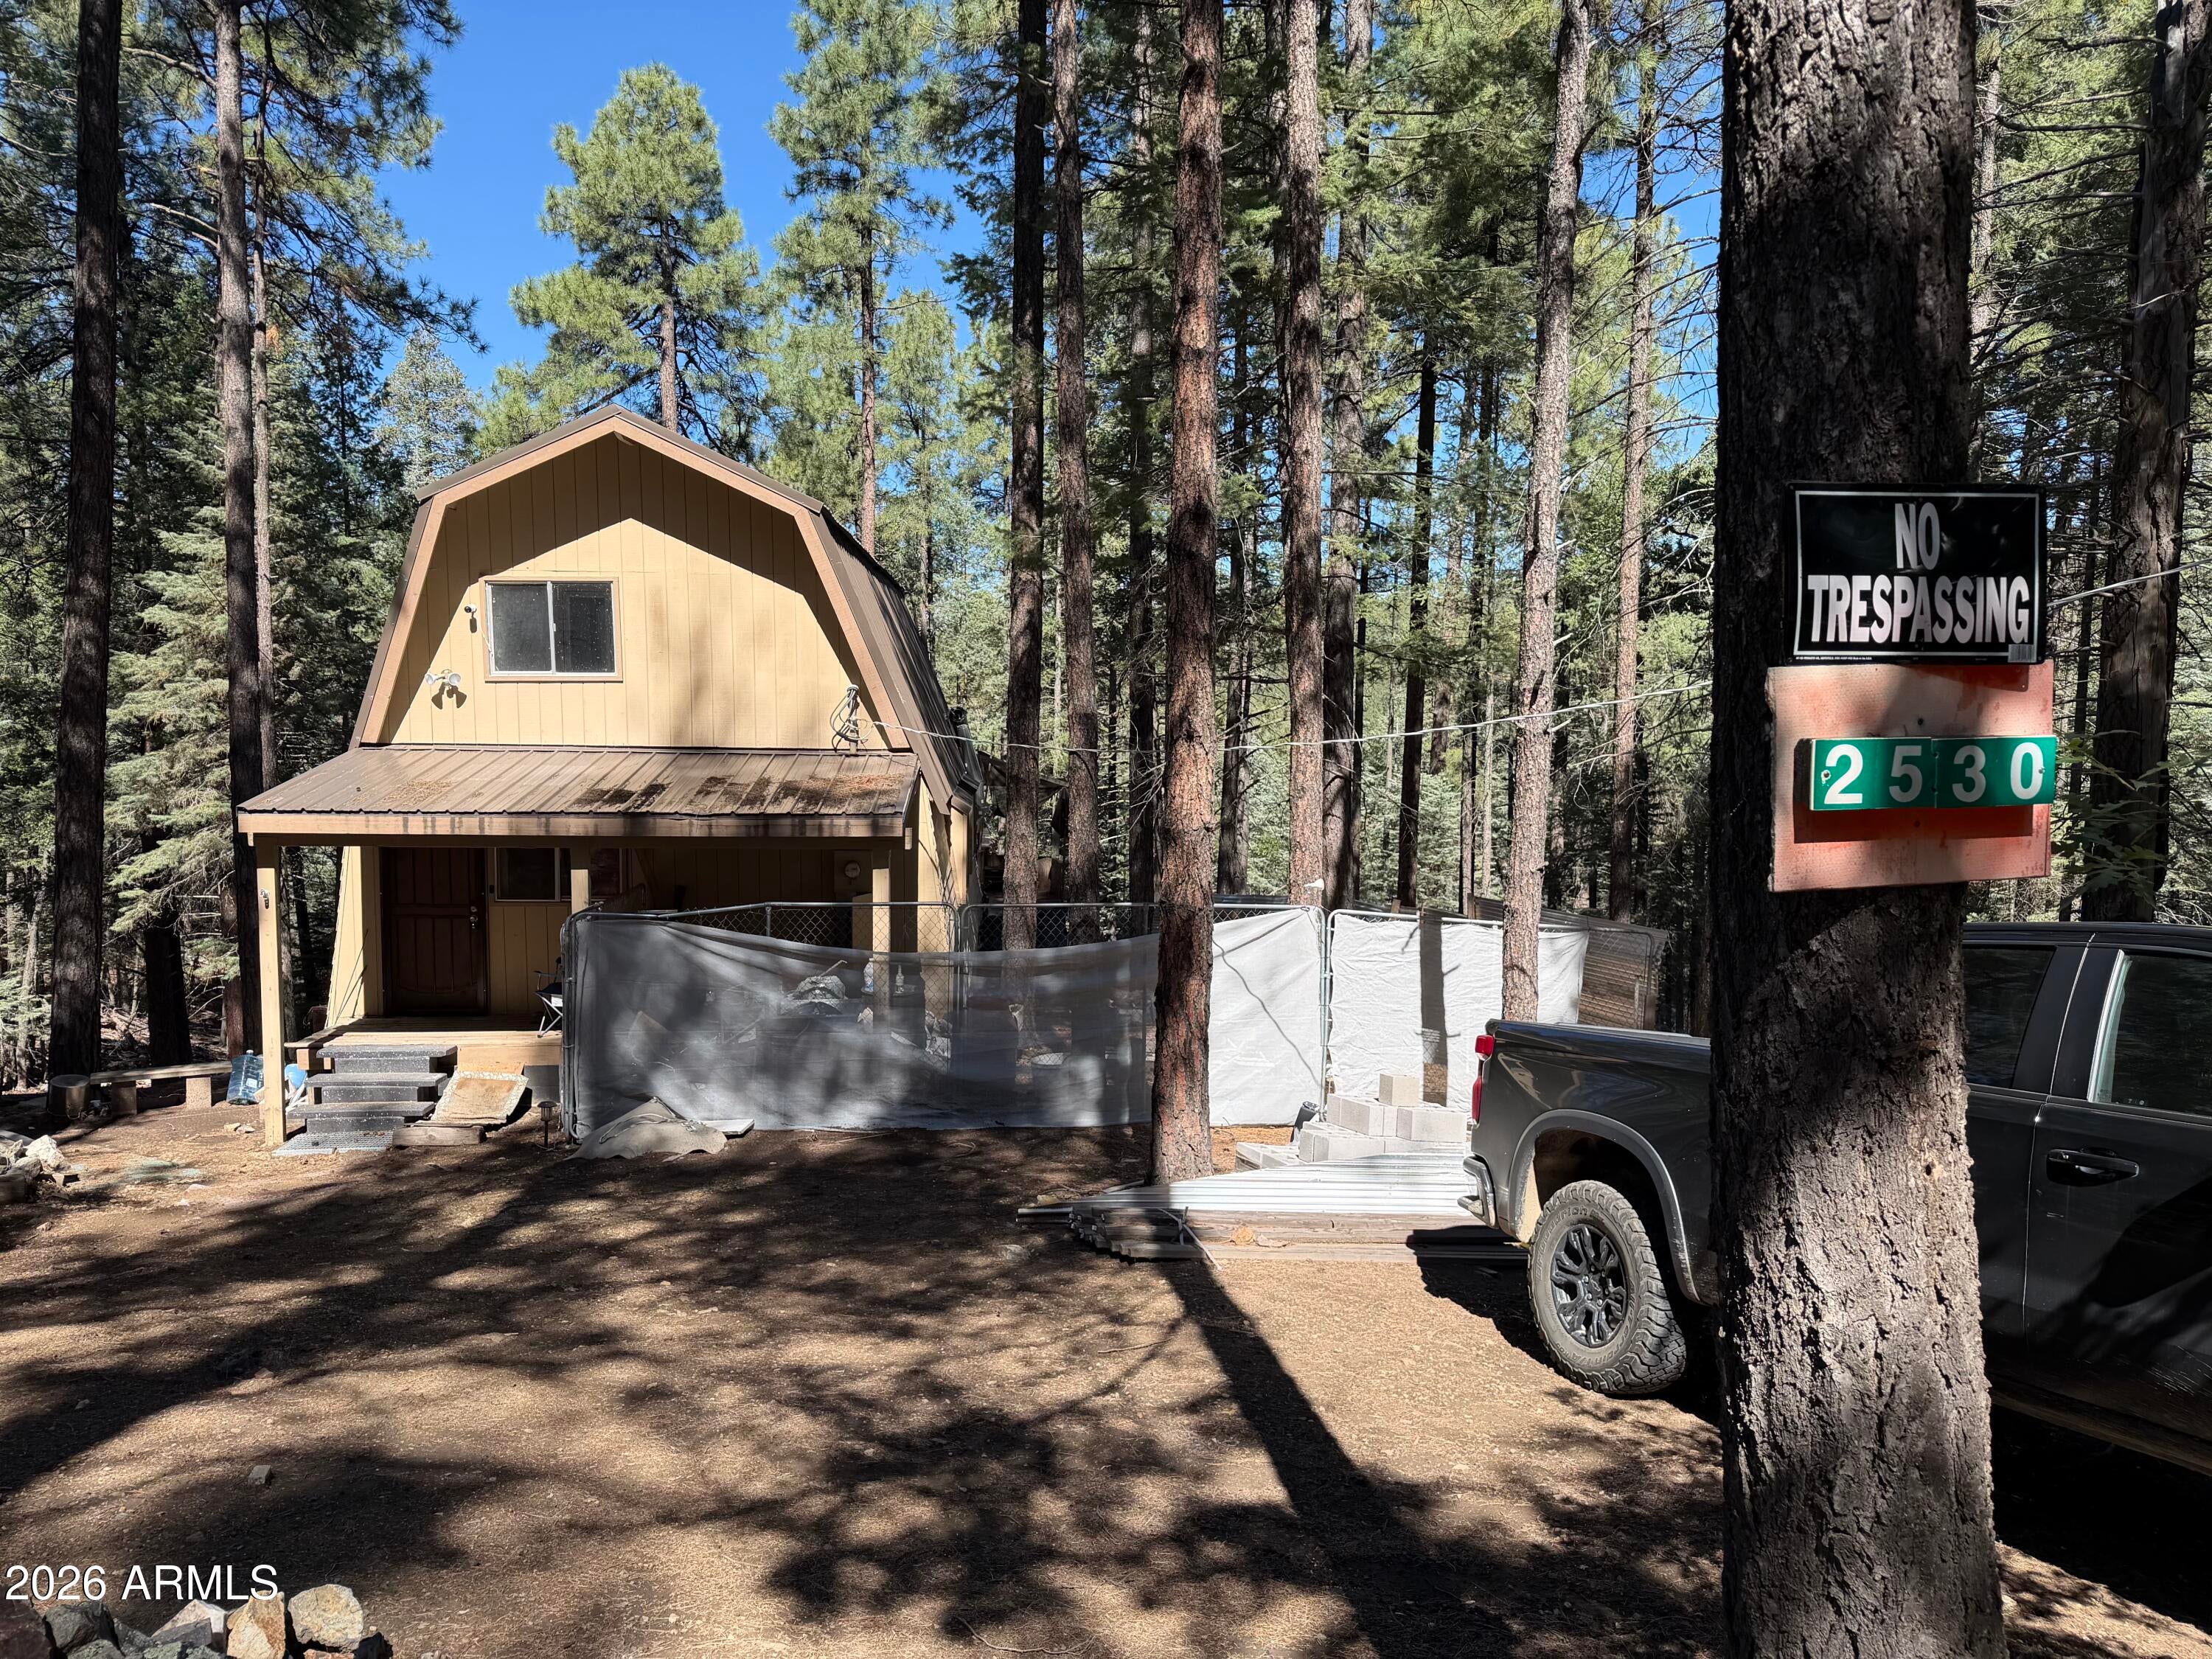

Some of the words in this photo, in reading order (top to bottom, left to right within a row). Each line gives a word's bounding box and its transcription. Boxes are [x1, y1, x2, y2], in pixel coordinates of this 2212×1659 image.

[1894, 502, 1940, 570] NO
[1807, 574, 2030, 644] TRESPASSING
[1823, 742, 2045, 804] 2530
